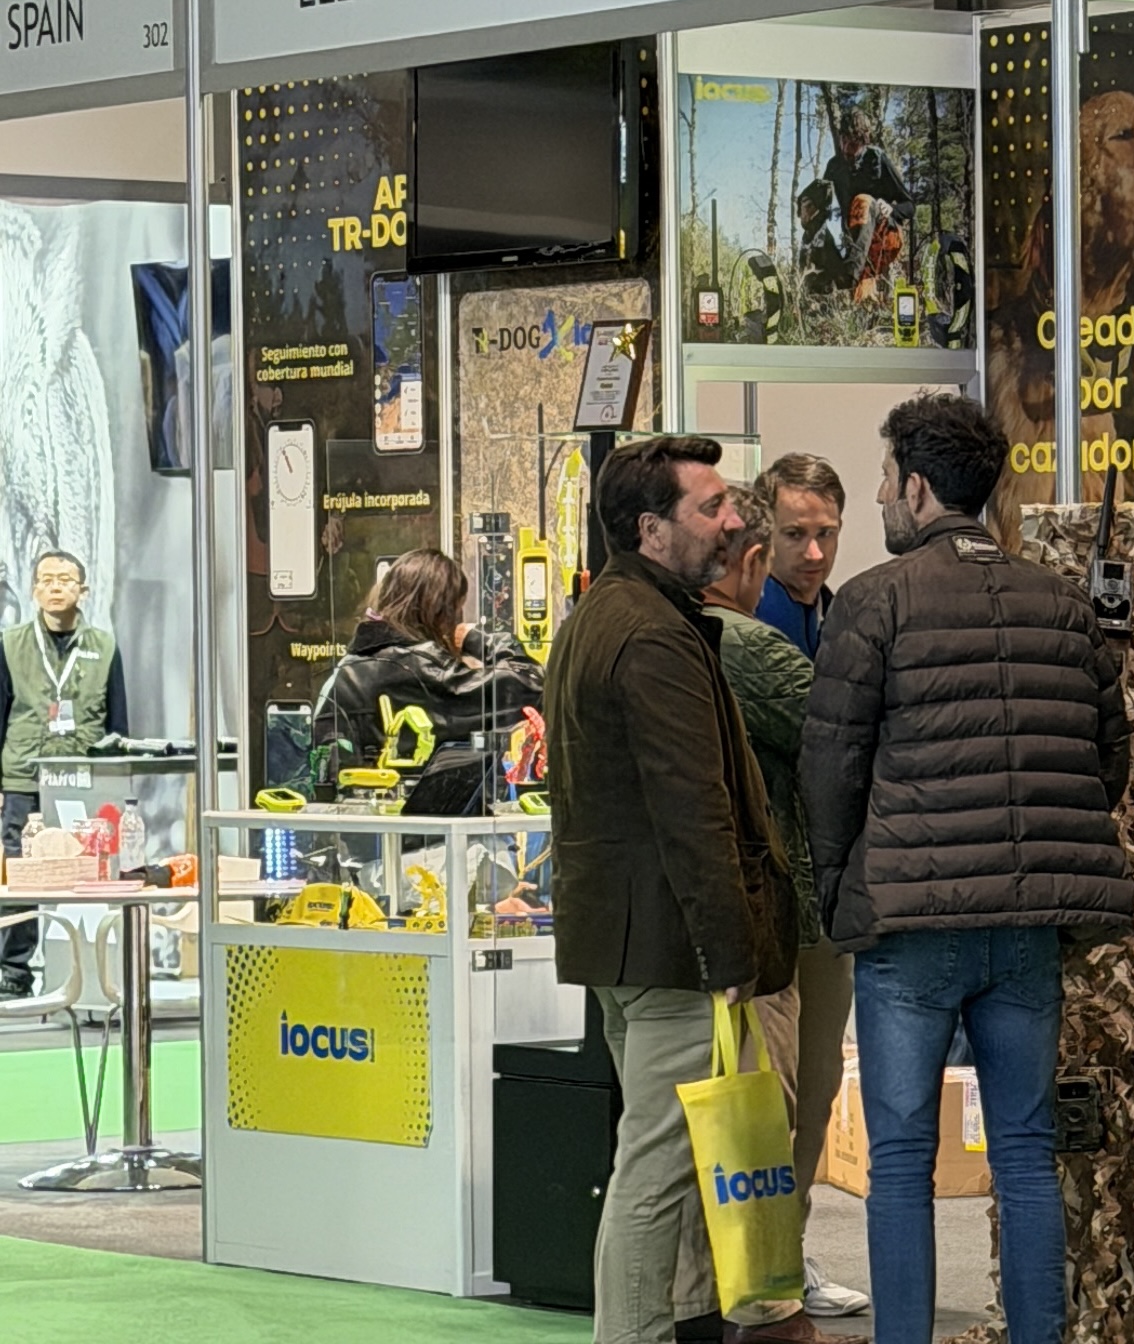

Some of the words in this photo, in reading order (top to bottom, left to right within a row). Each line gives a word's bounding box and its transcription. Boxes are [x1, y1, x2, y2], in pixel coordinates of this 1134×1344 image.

[142, 22, 169, 49] 302
[327, 211, 406, 252] TR-DO
[261, 343, 326, 365] Seguimiento
[328, 343, 348, 356] con
[256, 364, 307, 382] cobertura
[310, 360, 354, 378] mundial
[364, 490, 430, 511] incorporada
